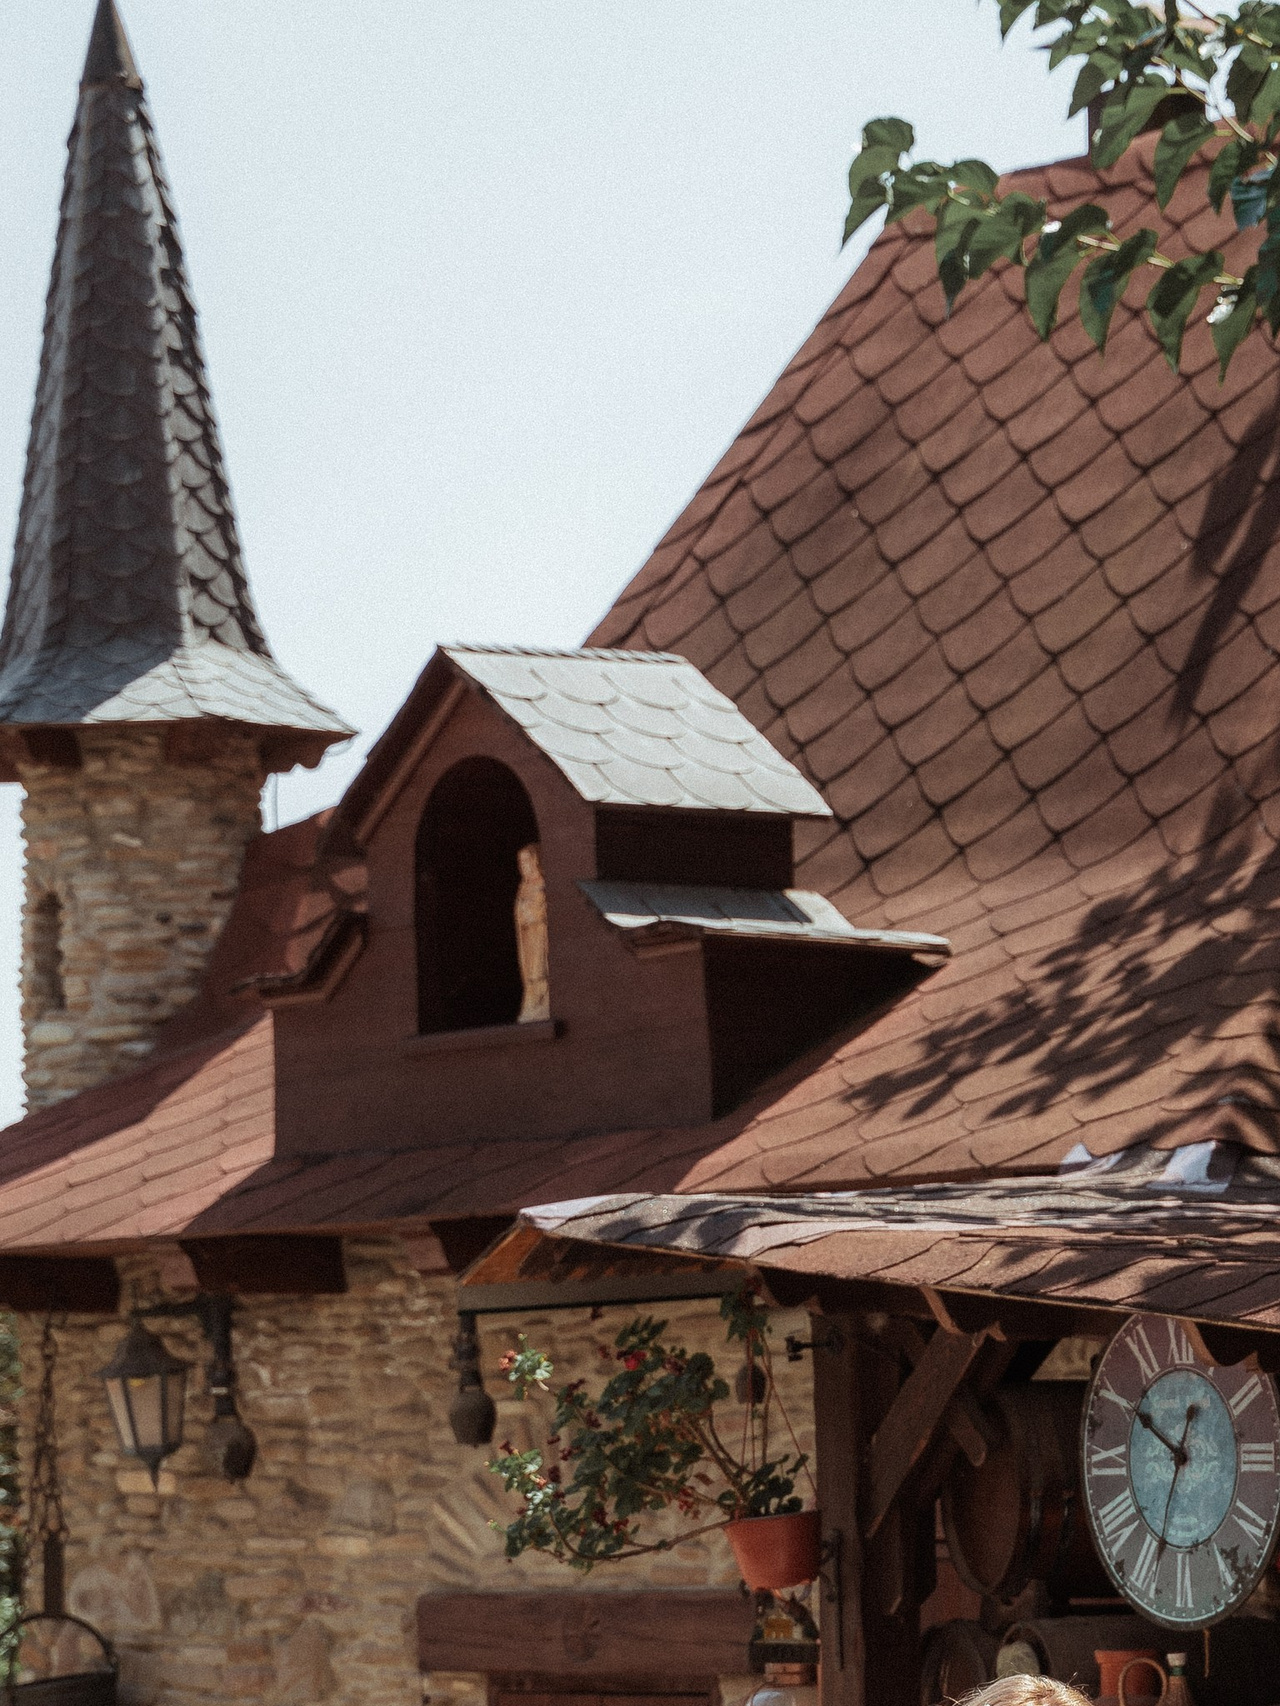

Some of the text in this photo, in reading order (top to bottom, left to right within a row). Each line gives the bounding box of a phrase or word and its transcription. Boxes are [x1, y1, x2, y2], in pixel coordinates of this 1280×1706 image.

[1125, 1323, 1161, 1384] XI
[1098, 1376, 1136, 1421] X
[1228, 1373, 1263, 1417] II
[1091, 1444, 1126, 1475] IX
[1241, 1443, 1275, 1473] III
[1098, 1487, 1140, 1556] VIII
[1231, 1498, 1267, 1547] IV
[1129, 1532, 1161, 1599] VII
[1175, 1552, 1194, 1609] VI
